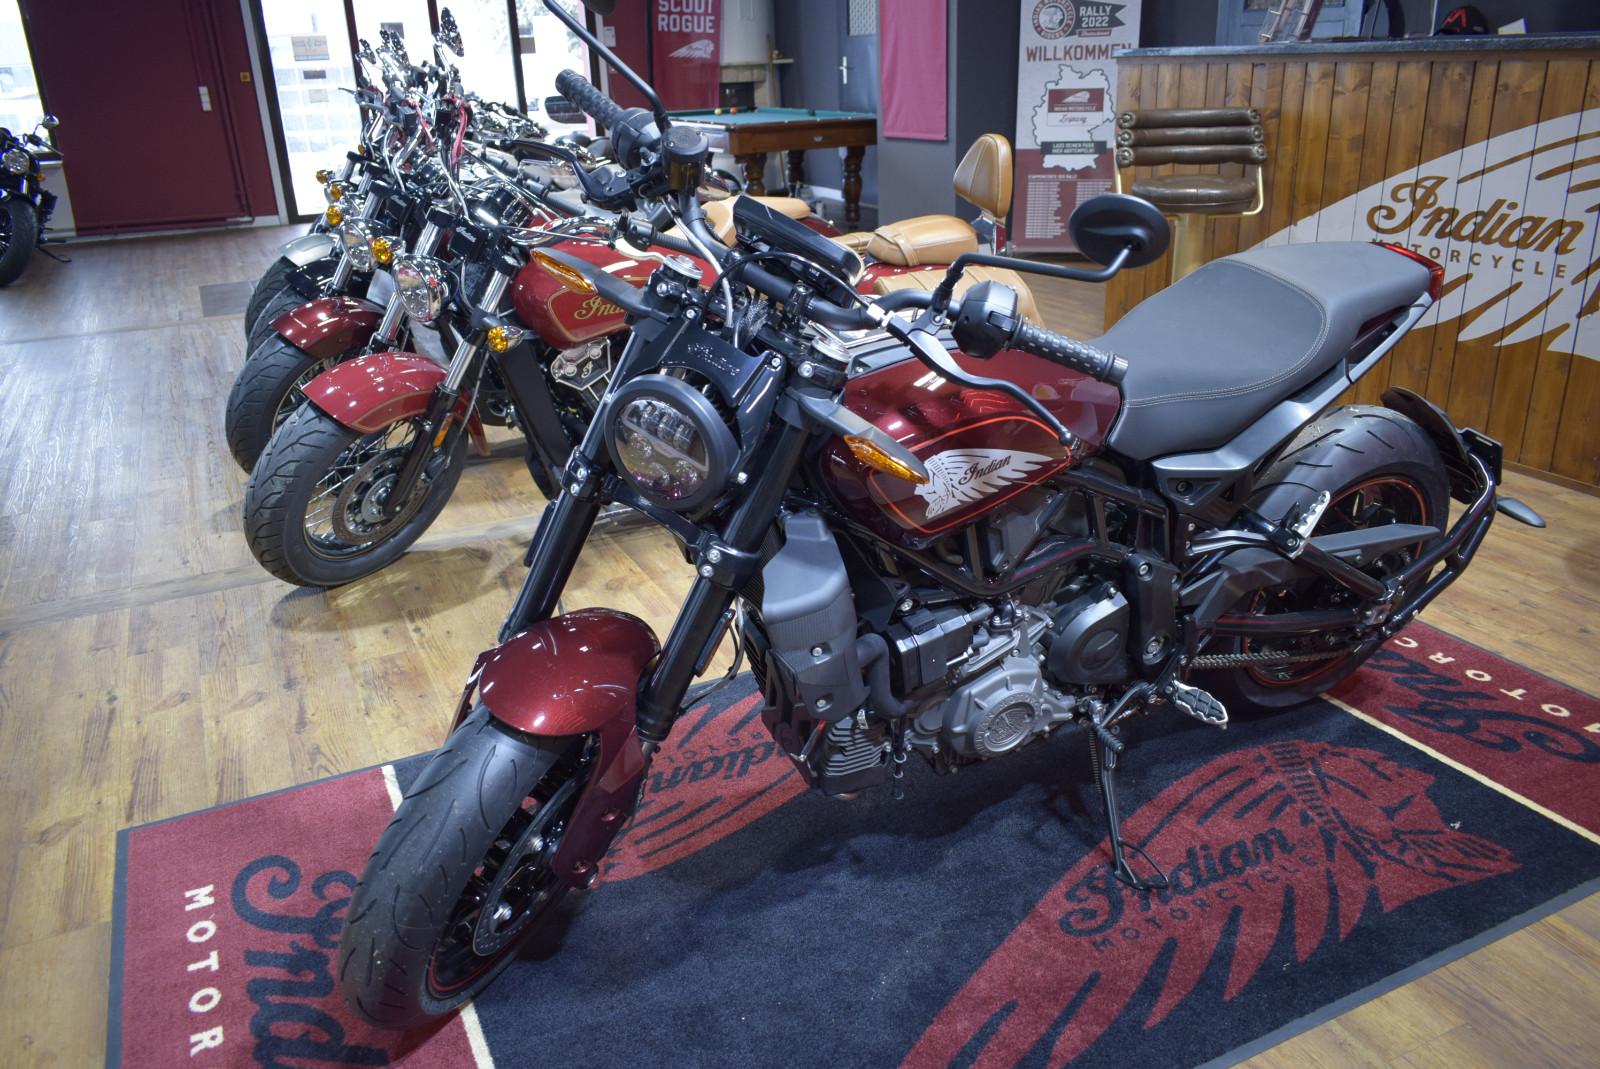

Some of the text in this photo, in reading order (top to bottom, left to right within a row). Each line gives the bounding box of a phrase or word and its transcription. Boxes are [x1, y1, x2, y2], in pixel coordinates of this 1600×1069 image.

[657, 14, 716, 33] ROGUE
[1080, 5, 1112, 17] RALLY
[1081, 16, 1109, 28] 2022
[1366, 175, 1584, 255] Indian
[1371, 238, 1567, 278] TORCYCLE
[958, 455, 1012, 485] Indian
[1059, 827, 1297, 937] Indian
[184, 884, 224, 1057] MOTOR
